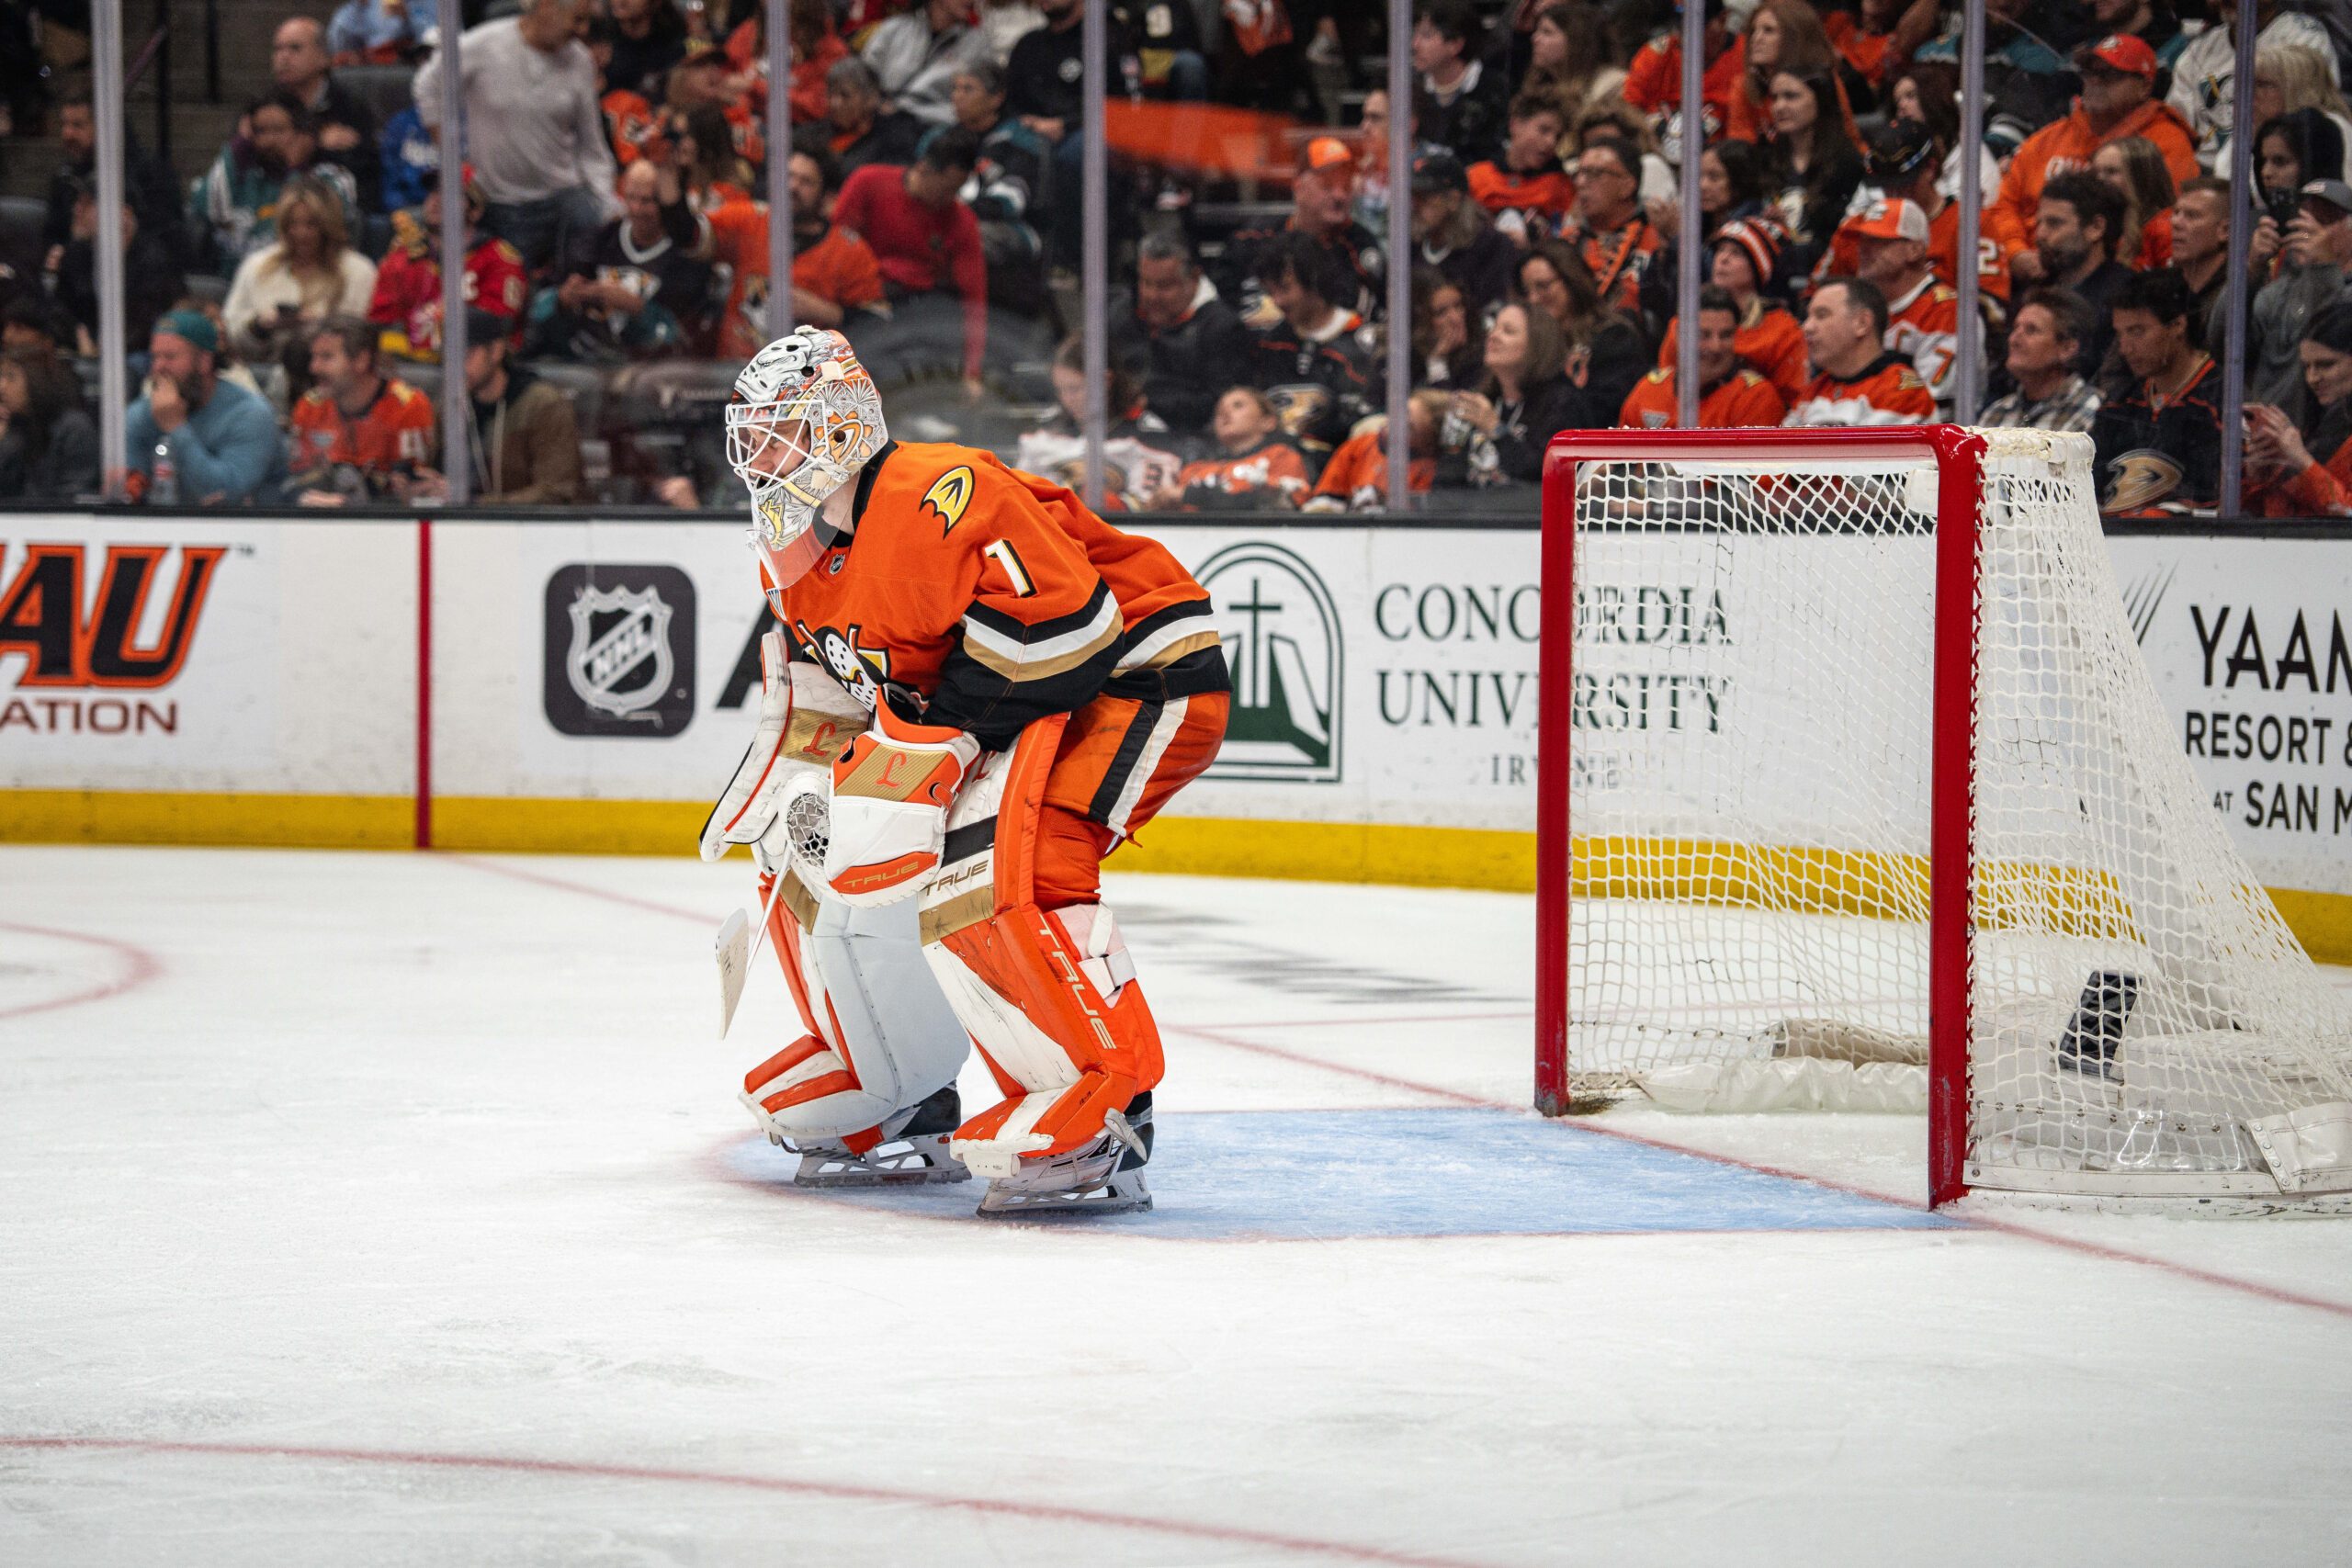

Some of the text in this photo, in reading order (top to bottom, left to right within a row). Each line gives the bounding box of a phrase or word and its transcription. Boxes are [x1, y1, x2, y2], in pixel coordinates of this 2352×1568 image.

[984, 539, 1039, 598] 1
[0, 540, 230, 690] AU
[1375, 669, 1734, 735] UNIVRSITY
[2185, 711, 2332, 765] RESORT
[876, 751, 907, 788] L
[2213, 791, 2233, 812] AT
[2245, 780, 2319, 832] SAN
[843, 861, 920, 888] TRUE
[920, 859, 989, 897] TRUE
[1037, 911, 1117, 1050] TRUE
